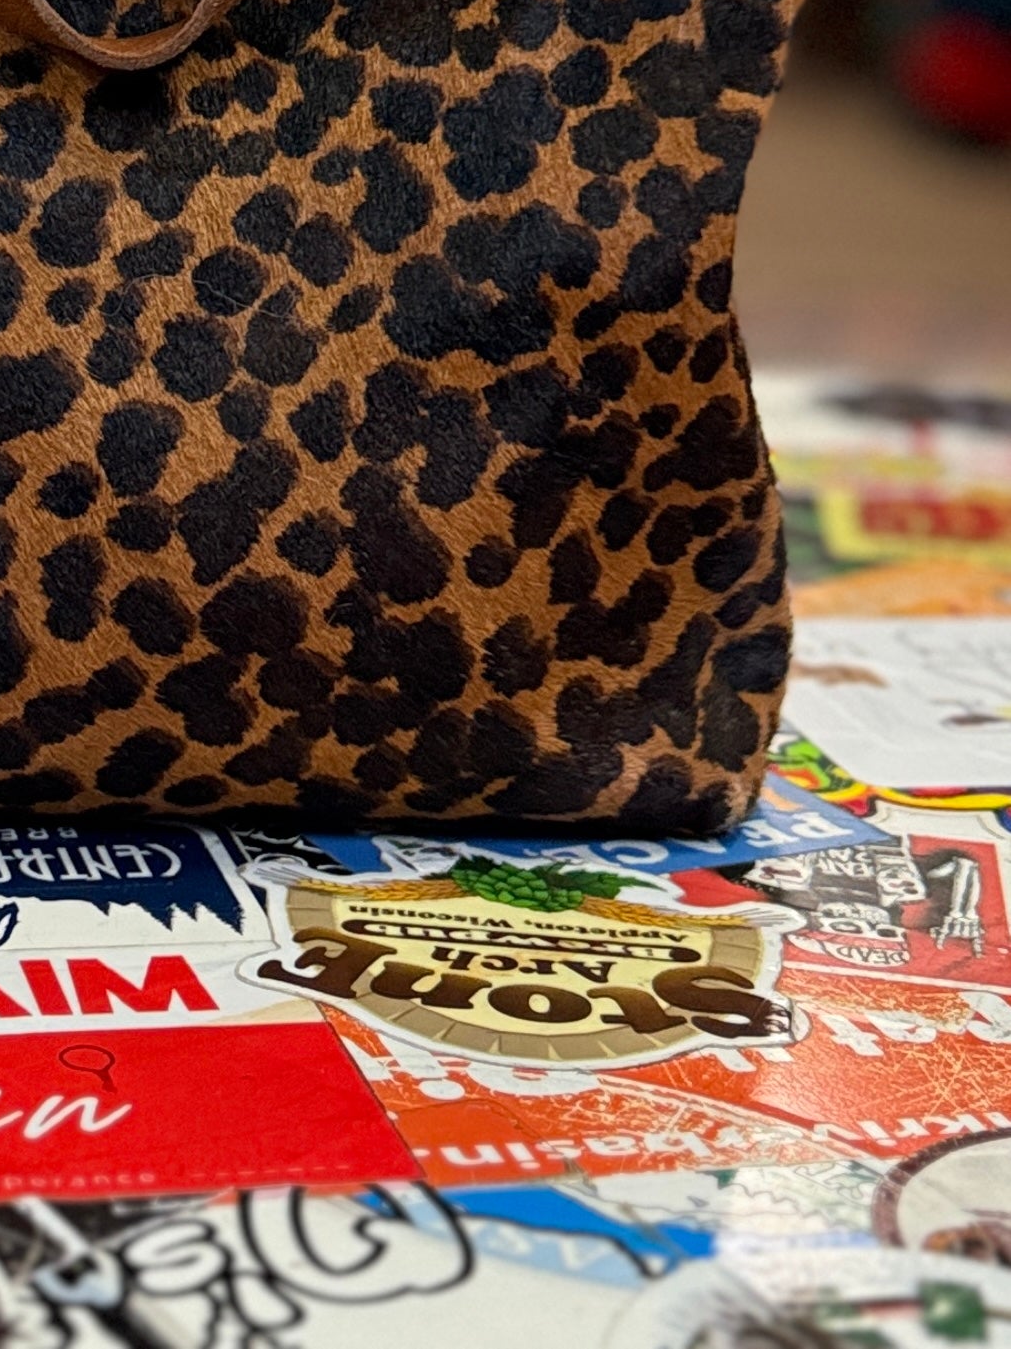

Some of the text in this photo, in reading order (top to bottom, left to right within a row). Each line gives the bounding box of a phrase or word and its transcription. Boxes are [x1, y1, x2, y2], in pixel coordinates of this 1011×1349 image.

[347, 905, 690, 945] Appleton, Wisconsin
[431, 946, 617, 984] Arch
[836, 946, 906, 965] DEAD
